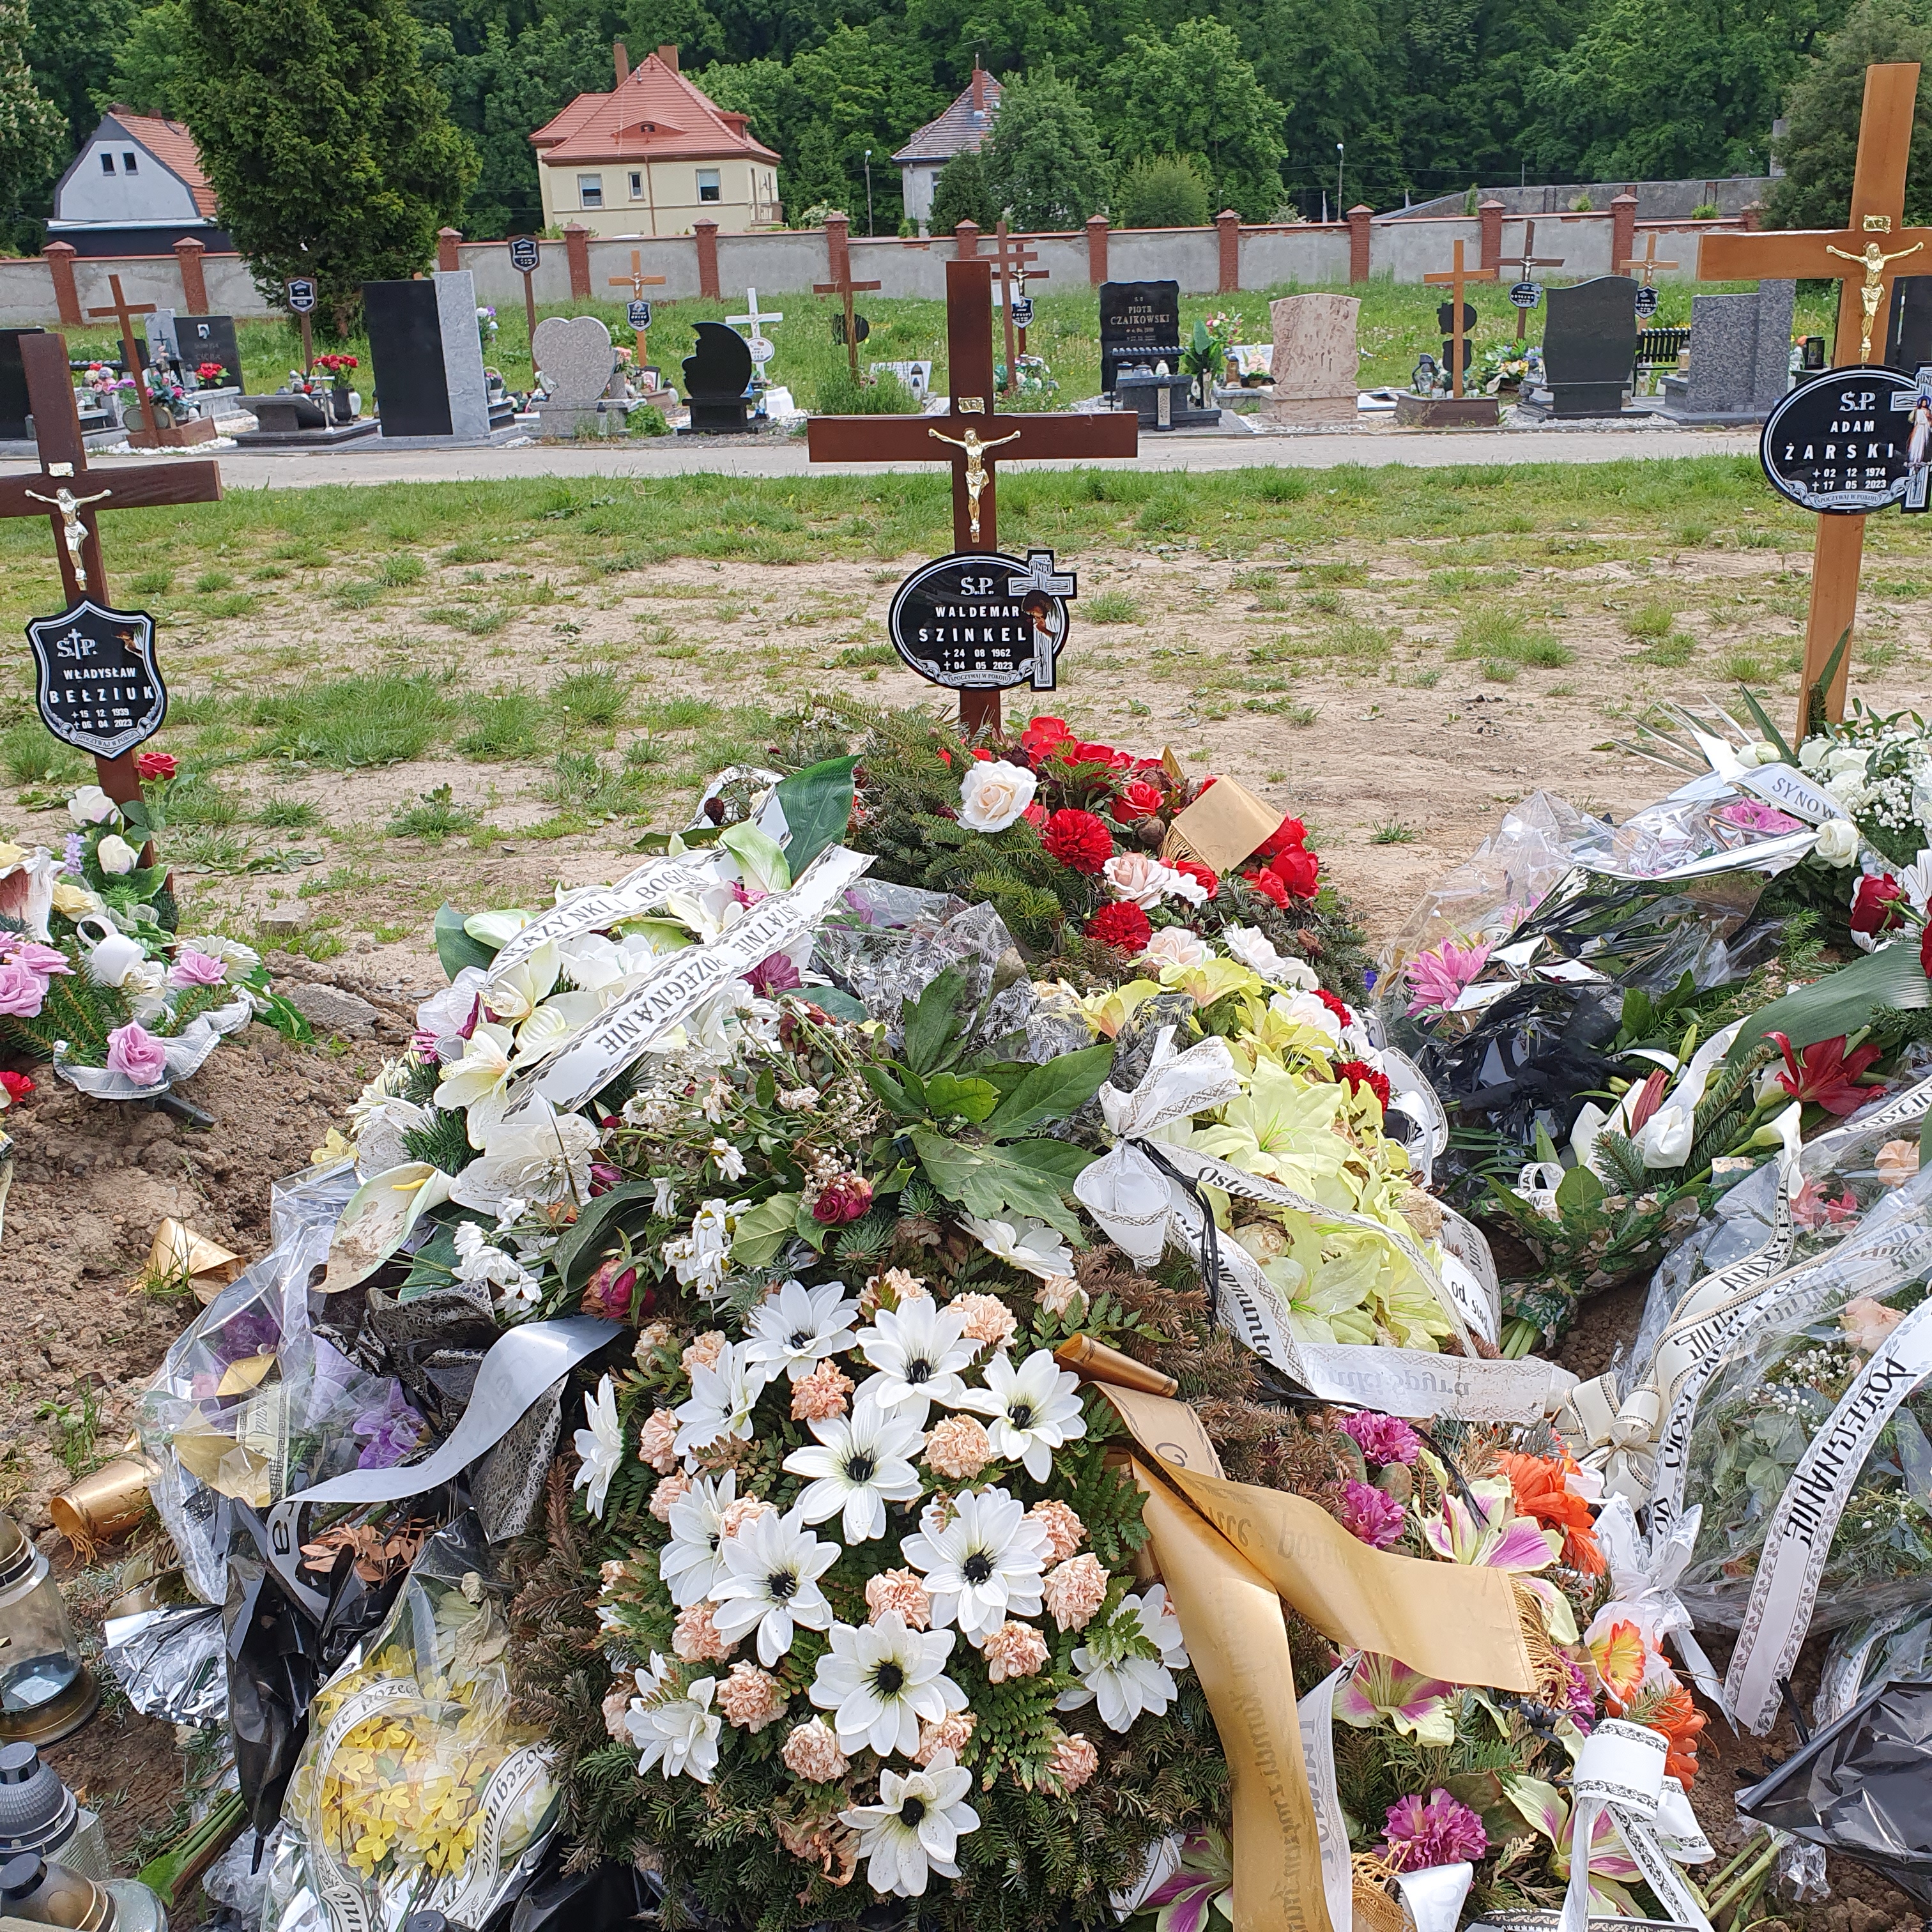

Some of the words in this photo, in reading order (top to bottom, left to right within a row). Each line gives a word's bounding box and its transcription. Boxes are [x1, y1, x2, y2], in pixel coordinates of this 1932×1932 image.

[1128, 305, 1152, 314] PIOTR
[1110, 314, 1170, 325] CZAJKOWSKI
[1830, 420, 1875, 433] ADAM
[1784, 442, 1894, 460] ŻARSKI
[1823, 468, 1836, 478] 02
[1846, 468, 1857, 477] 12
[1865, 467, 1886, 477] 1974
[1823, 480, 1834, 490] 17
[1845, 480, 1857, 489] 05
[1864, 479, 1887, 489] 2023
[935, 606, 1020, 618] WALDEMAR
[919, 627, 1027, 642] SZINKEL
[953, 649, 965, 657] 24
[974, 649, 985, 657] 08
[991, 648, 1011, 657] 1962
[993, 662, 1013, 670] 2023
[63, 667, 136, 680] WŁADYSŁAW
[951, 672, 981, 682] SPOCZYWAJ
[49, 686, 155, 703] BEŁZIUK
[79, 710, 89, 718] 15
[111, 708, 130, 716] 1939
[98, 719, 109, 728] 04
[114, 719, 133, 727] 2023
[735, 903, 803, 956] OSTATNIE
